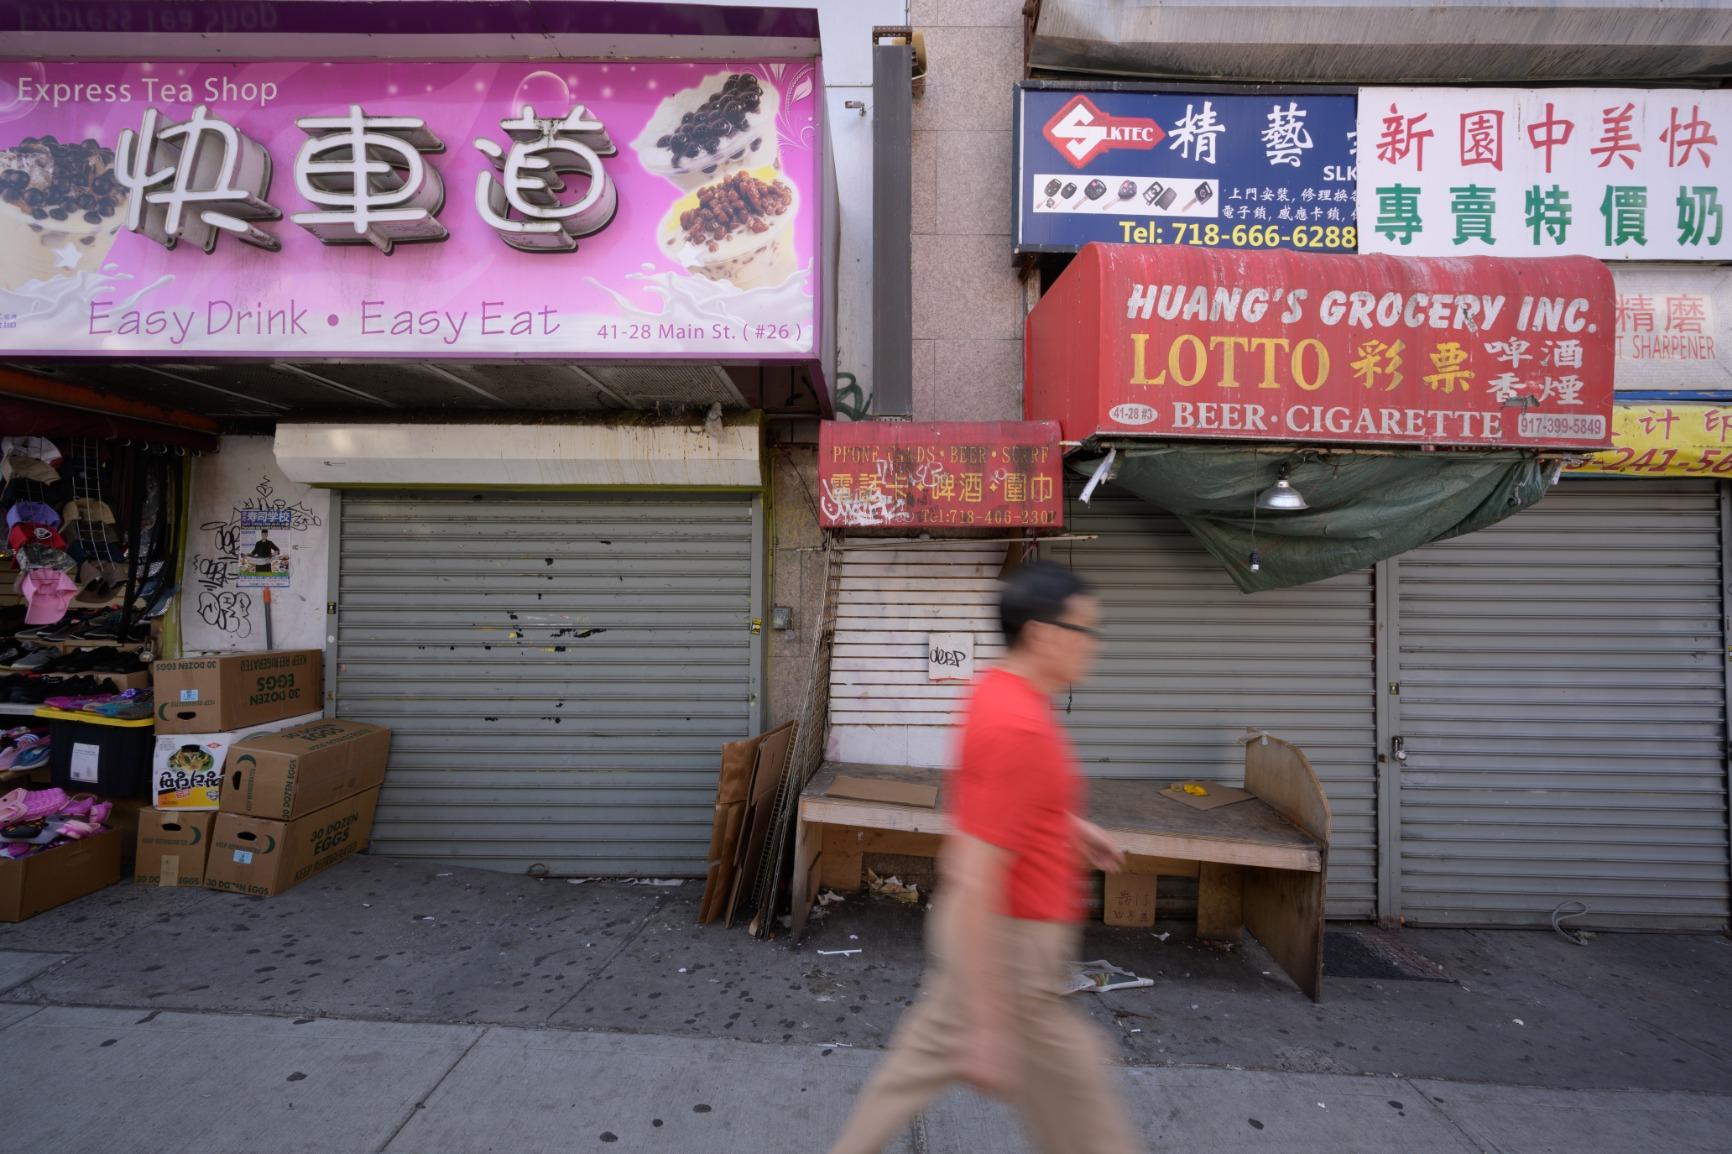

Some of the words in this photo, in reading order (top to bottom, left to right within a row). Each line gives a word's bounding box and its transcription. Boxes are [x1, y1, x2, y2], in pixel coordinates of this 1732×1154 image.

[18, 77, 132, 107] Express
[141, 78, 193, 102] Tea
[204, 77, 279, 106] Shop
[1375, 102, 1718, 173] 新園中美快
[114, 103, 616, 253] 快車道
[1374, 183, 1724, 247] 專賣特價奶
[1119, 221, 1163, 244] Tel:
[1172, 222, 1358, 248] 718-666-6288
[88, 300, 196, 345] Easy
[207, 299, 308, 336] Drink
[361, 300, 468, 345] Easy
[481, 300, 561, 336] Eat
[1127, 283, 1308, 324] HUANG'S
[1319, 289, 1506, 334] GROCERY
[1516, 295, 1598, 334] INC.
[597, 323, 651, 340] 41-28
[659, 323, 704, 340] Main
[712, 323, 736, 340] St.
[1130, 333, 1330, 391] LOTTO
[1484, 337, 1584, 369] 啤酒
[1632, 335, 1716, 361] SHARPENER
[1350, 338, 1476, 394] 彩票
[1113, 407, 1140, 420] 41-28
[1172, 402, 1268, 431] BEER
[1286, 405, 1503, 438] CIGARETTE
[1520, 416, 1602, 435] 917-399-5849
[156, 662, 177, 671] EGGS
[178, 661, 205, 671] DOZEN
[256, 673, 295, 691] EGGS
[313, 827, 350, 856] EGGS
